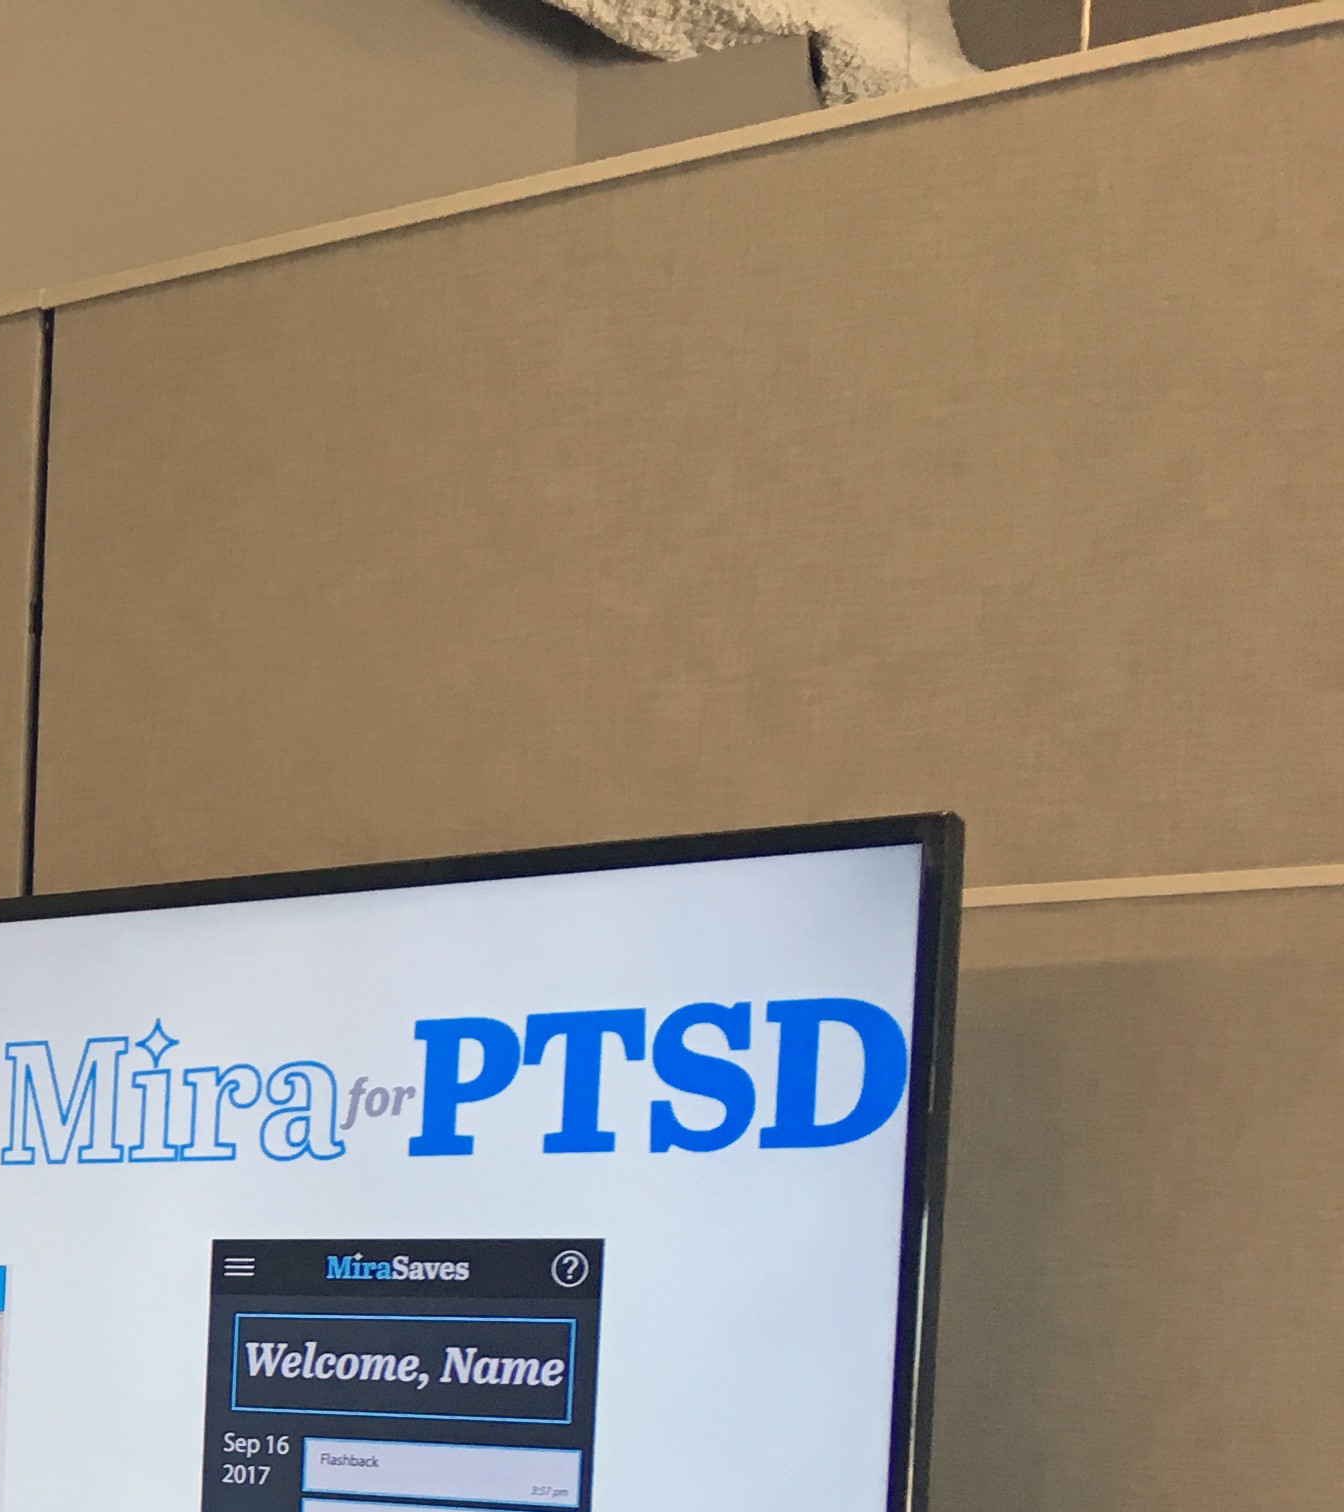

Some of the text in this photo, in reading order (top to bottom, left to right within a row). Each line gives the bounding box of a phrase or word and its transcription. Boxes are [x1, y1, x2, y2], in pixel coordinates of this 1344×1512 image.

[342, 1074, 416, 1130] for
[408, 997, 909, 1158] PTSD
[325, 1252, 470, 1281] MiraSaves
[245, 1341, 565, 1390] Welcome, Name
[222, 1432, 290, 1458] Sep 16
[320, 1452, 379, 1469] Flashback
[221, 1464, 271, 1486] 2017
